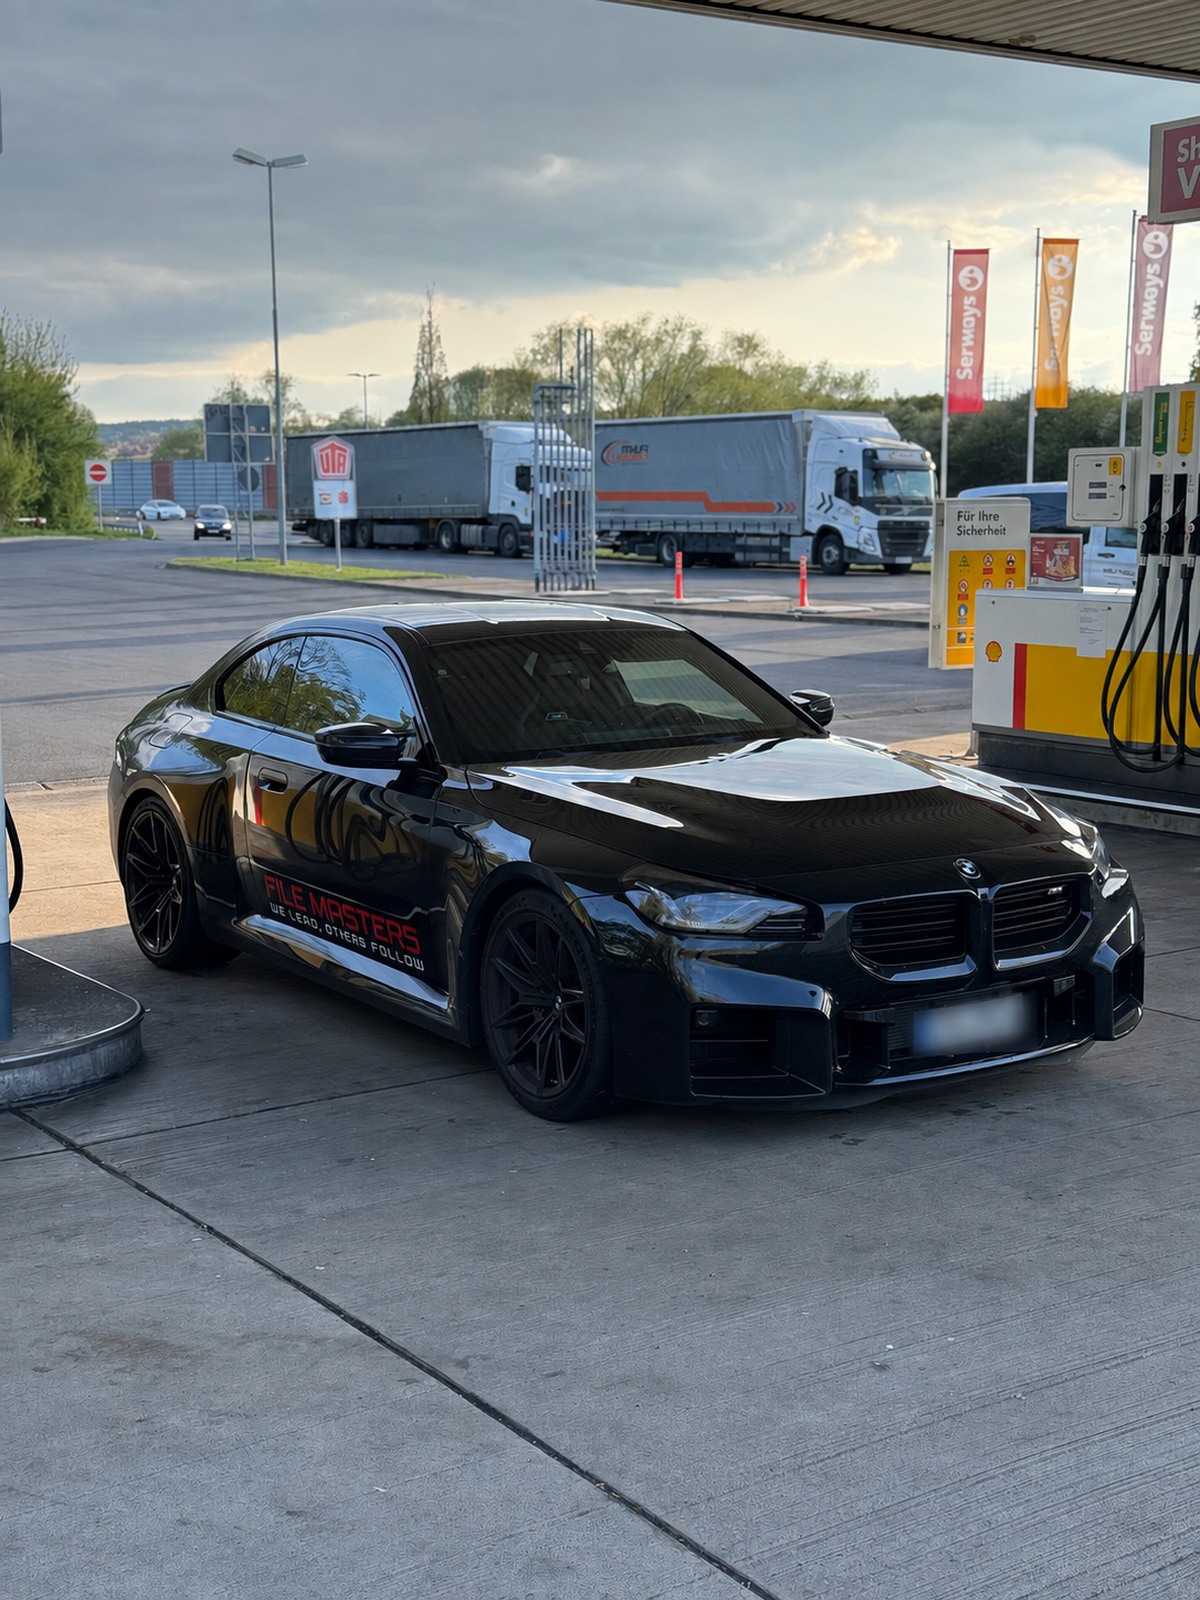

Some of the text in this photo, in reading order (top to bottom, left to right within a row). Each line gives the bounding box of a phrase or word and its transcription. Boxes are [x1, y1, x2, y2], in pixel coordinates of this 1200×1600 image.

[956, 295, 981, 380] Serways
[1135, 263, 1164, 356] Serways
[319, 442, 348, 474] UTA
[956, 524, 1006, 536] Sicherheit
[957, 510, 1000, 522] Für Ihre
[264, 874, 421, 955] FILE MASTERS
[269, 901, 286, 917] WE
[325, 923, 367, 949] OTHERS
[370, 941, 425, 972] FOLLOW
